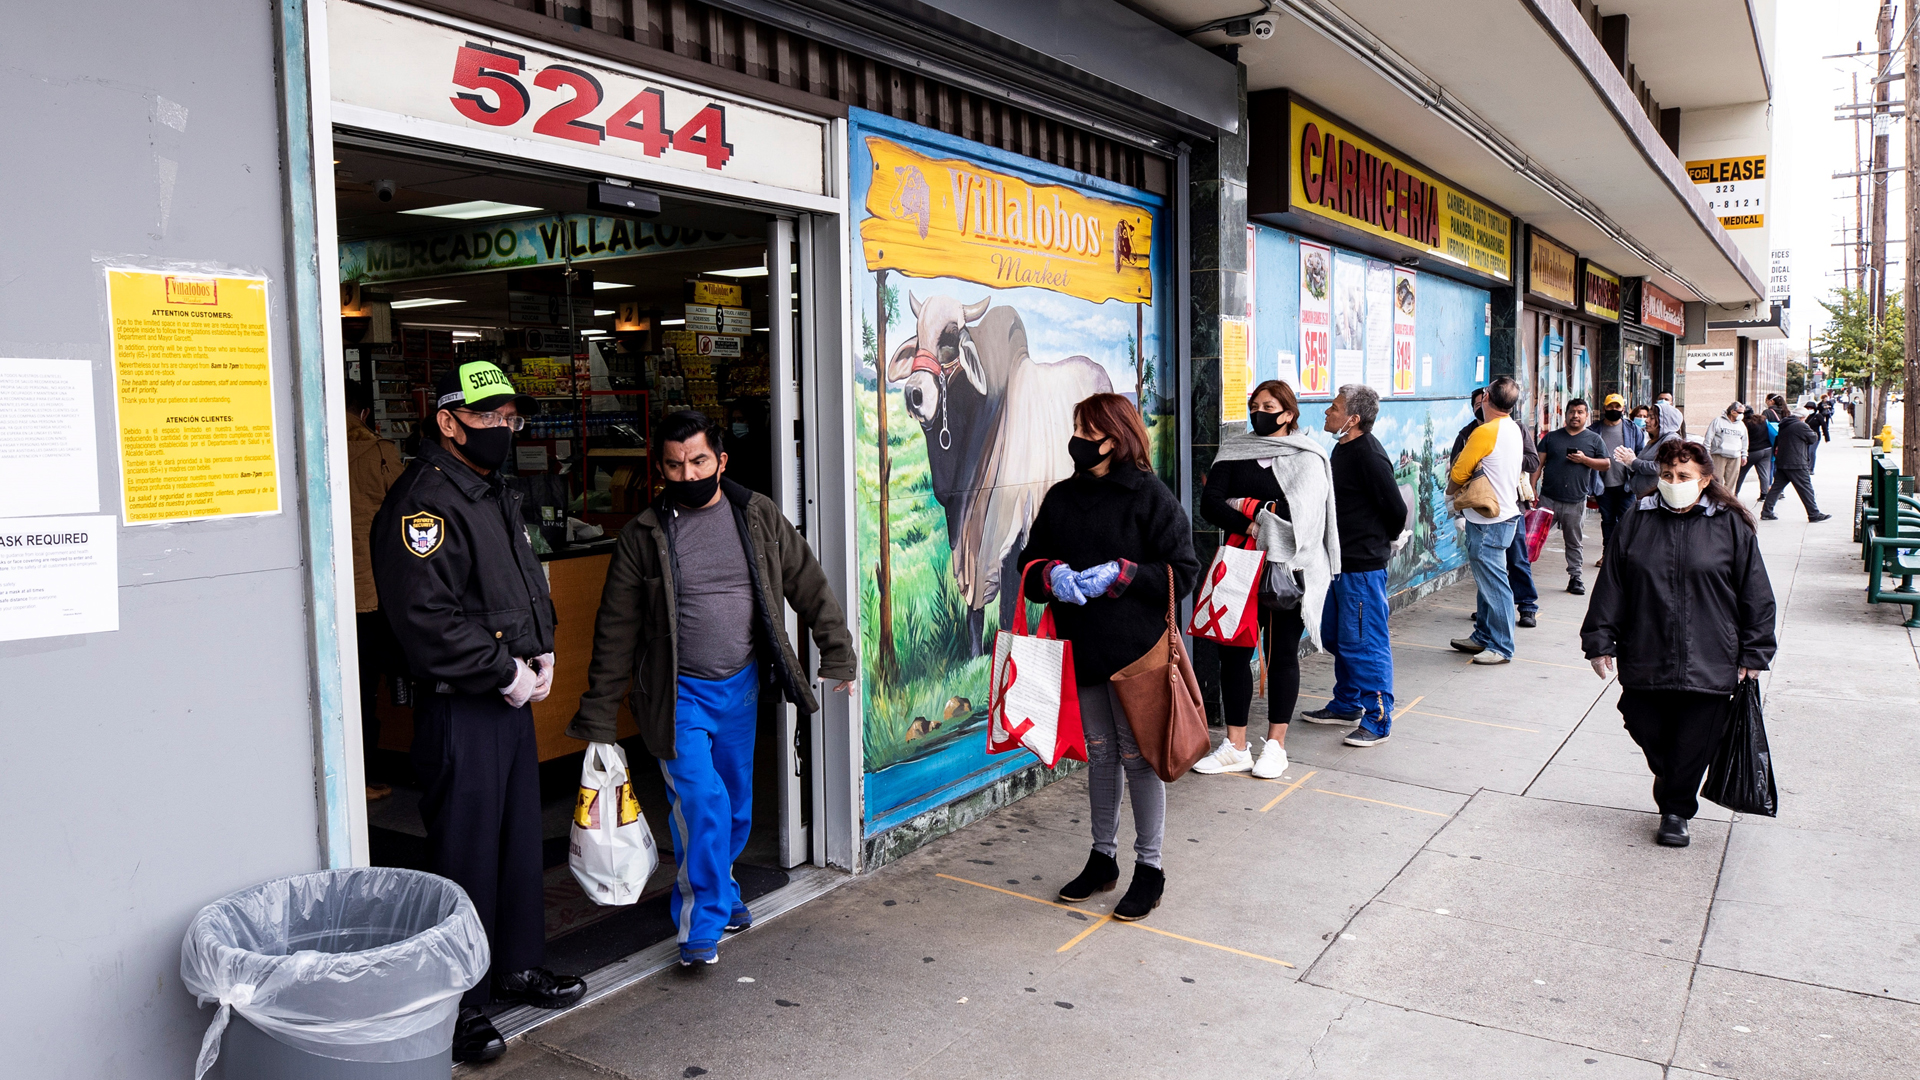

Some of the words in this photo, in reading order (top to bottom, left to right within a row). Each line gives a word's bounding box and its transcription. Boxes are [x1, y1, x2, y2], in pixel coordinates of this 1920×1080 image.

[448, 41, 734, 170] 5244
[1688, 168, 1709, 179] FOR
[1709, 159, 1764, 183] LEASE
[1301, 123, 1440, 248] CARNICERIA
[1716, 184, 1735, 193] 323
[946, 168, 1101, 258] Villalobos
[1724, 215, 1759, 225] MEDICAL
[366, 228, 517, 273] MERCADO
[539, 217, 752, 259] VILLALOB
[991, 253, 1071, 287] Market
[1538, 244, 1568, 292] Villalobos
[172, 280, 210, 296] Villalobos
[191, 311, 233, 319] CUSTOMERS:
[624, 307, 633, 322] 2
[717, 308, 723, 325] 3
[179, 362, 198, 370] changed
[166, 415, 199, 423] ATENCIÓN
[165, 510, 188, 518] paciencia
[543, 520, 564, 528] LIVNG
[27, 533, 88, 546] REQUIRED
